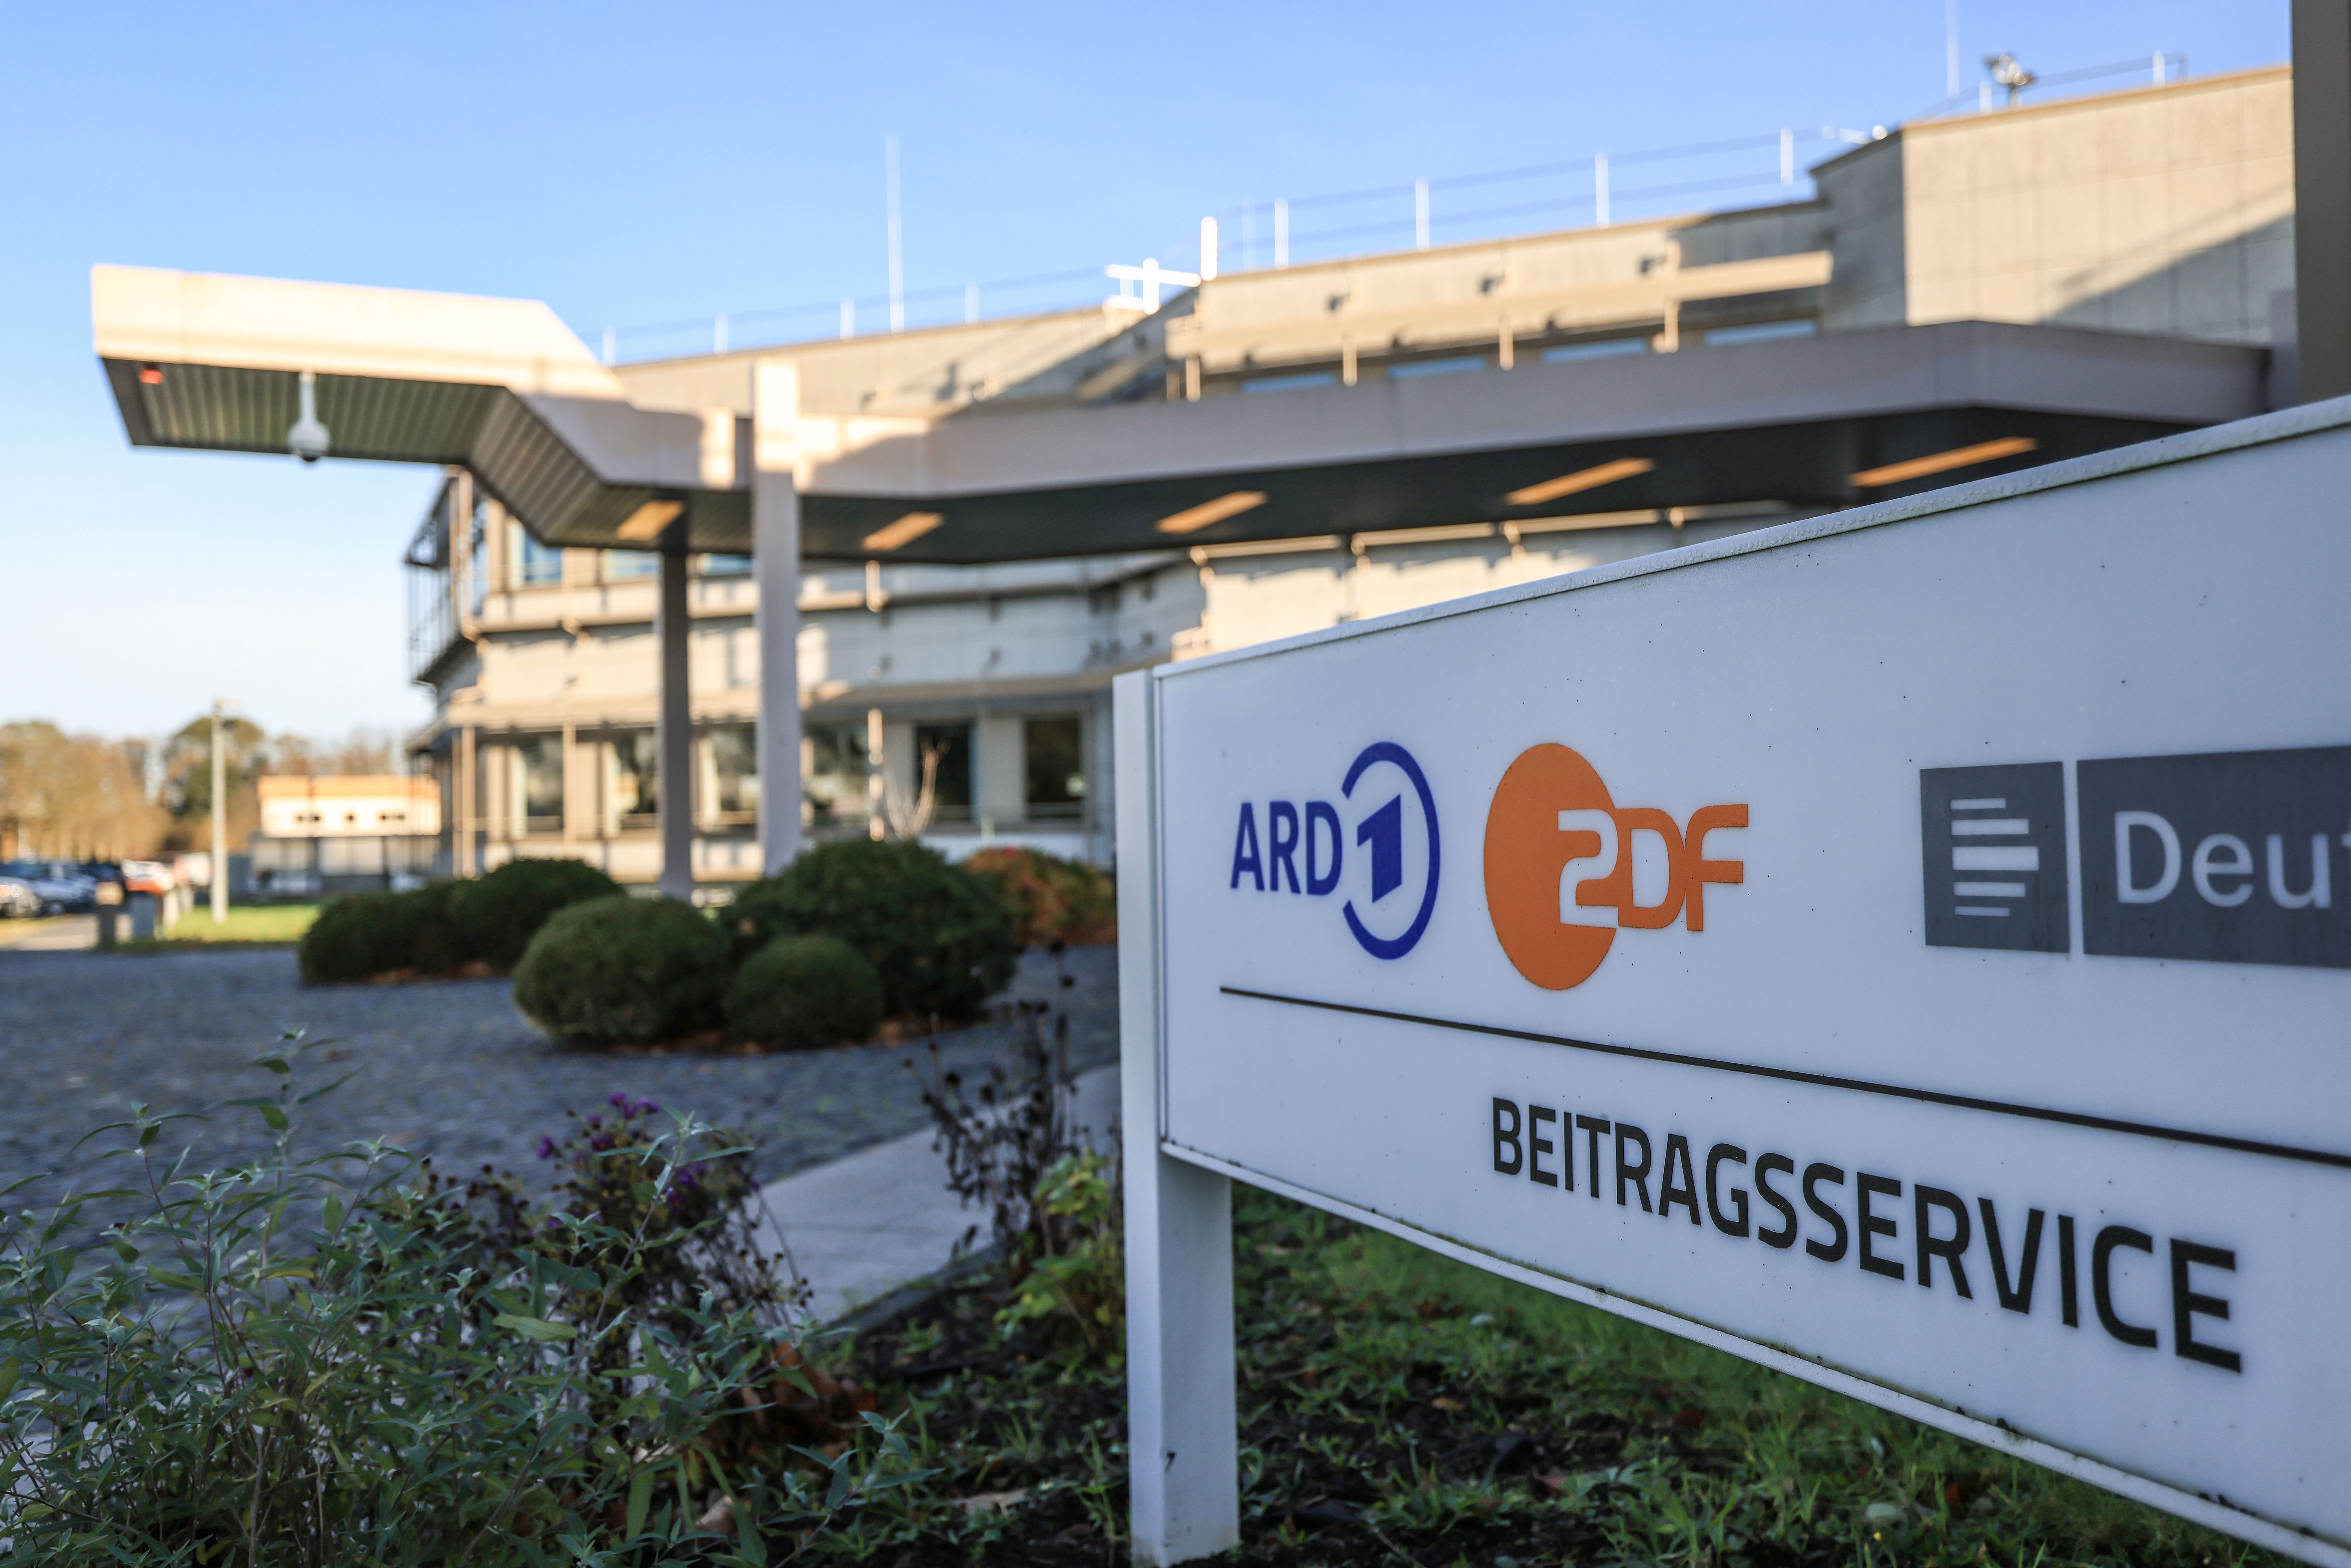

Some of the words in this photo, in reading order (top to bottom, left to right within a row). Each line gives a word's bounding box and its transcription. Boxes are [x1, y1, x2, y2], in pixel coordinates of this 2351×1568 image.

[1230, 800, 1343, 896] ARD
[2114, 810, 2351, 909] Deu
[1492, 1096, 2243, 1374] BEITRAGSSERVICE
